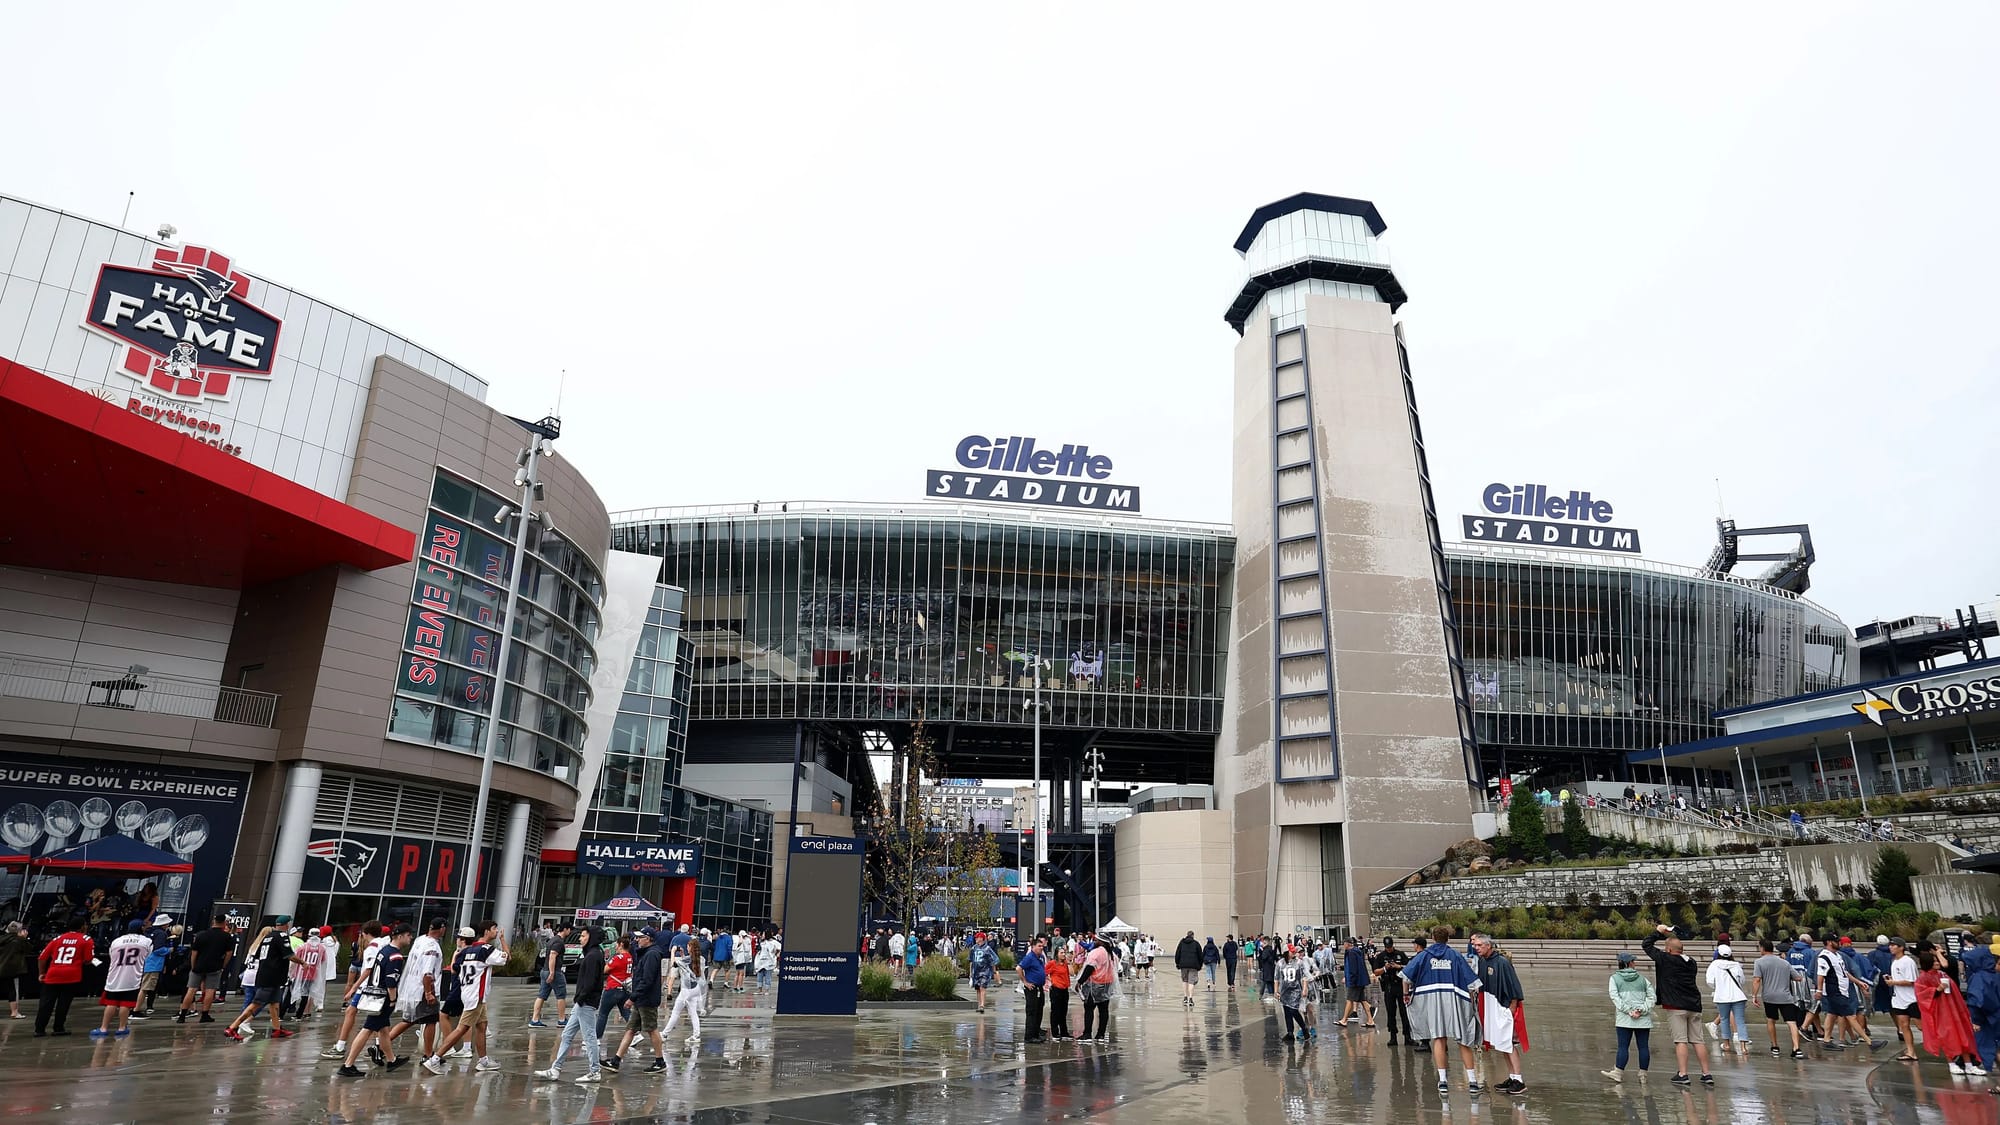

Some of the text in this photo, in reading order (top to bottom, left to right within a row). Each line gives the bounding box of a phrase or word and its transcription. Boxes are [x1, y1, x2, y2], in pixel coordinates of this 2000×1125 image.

[152, 282, 236, 322] HALL
[183, 308, 203, 319] OF
[101, 290, 265, 367] FAME
[142, 395, 185, 412] PRESENTED
[126, 397, 221, 435] Raytheon
[955, 434, 1113, 480] Gillette
[935, 474, 1132, 508] STADIUM
[1482, 482, 1614, 523] Gillette
[1471, 519, 1632, 549] STADIUM
[1902, 702, 1998, 722] INSURANC
[95, 767, 128, 775] VISIT
[0, 769, 239, 798] SUPER BOWL EXPERIENCE
[934, 787, 986, 795] STADIUM
[585, 844, 636, 859] HALL
[646, 847, 694, 861] FAME
[800, 839, 853, 852] enel plaza
[577, 909, 597, 919] 98.5
[54, 946, 77, 965] 12
[117, 947, 140, 966] 12
[306, 951, 319, 965] 10
[973, 950, 984, 963] 12
[461, 965, 477, 987] 12
